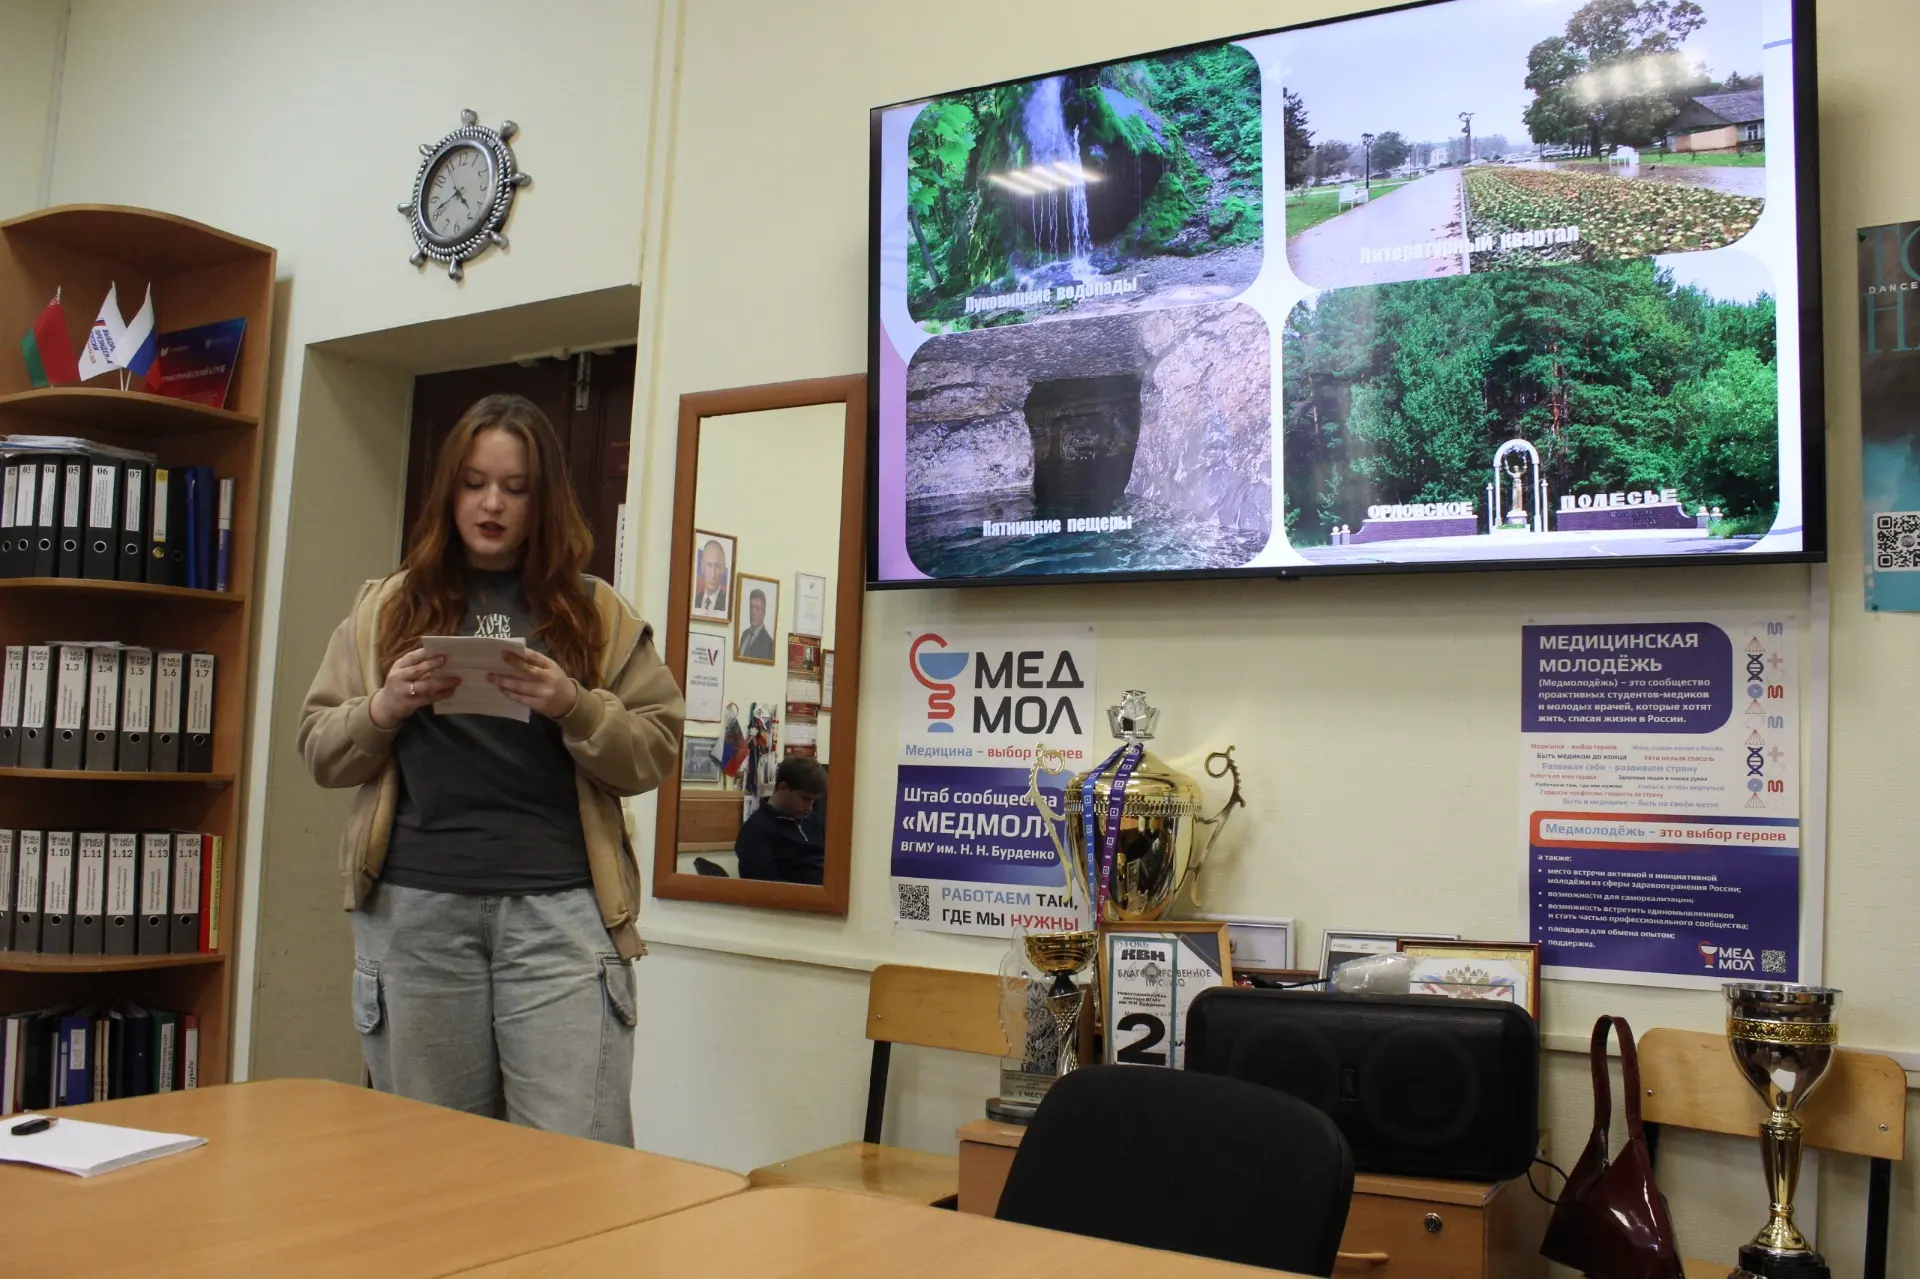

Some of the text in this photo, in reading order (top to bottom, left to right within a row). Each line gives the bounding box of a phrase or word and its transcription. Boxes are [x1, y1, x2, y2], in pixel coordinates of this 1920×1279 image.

[459, 152, 468, 167] 12
[471, 154, 479, 168] 1
[446, 160, 455, 174] 11
[478, 169, 489, 177] 2
[434, 175, 446, 188] 10
[430, 196, 440, 204] 9
[442, 219, 450, 232] 7
[454, 221, 460, 235] 6
[1500, 226, 1580, 250] квартал
[1057, 278, 1137, 301] водопады
[1869, 282, 1918, 294] DANCE
[7, 467, 16, 476] 02
[22, 466, 31, 474] 03
[45, 466, 55, 474] 04
[68, 466, 79, 475] 05
[97, 467, 108, 475] 06
[129, 471, 140, 479] 07
[1367, 488, 1678, 519] ОРЛОВСКОЕ ПОЛЕСЬЕ
[983, 515, 1132, 537] Пятницкие пещеры
[1539, 633, 1699, 652] МЕДИЦИНСКАЯ
[31, 662, 45, 671] 1.2
[65, 663, 80, 671] 1.3
[98, 665, 113, 673] 1.4
[974, 650, 1084, 689] МЕД
[1539, 655, 1662, 674] МОЛОДЁЖЬ
[130, 667, 145, 676] 1.5
[163, 668, 177, 677] 1.6
[196, 669, 209, 678] 1.7
[1538, 678, 1618, 688] (Медмолодёжь)
[1648, 678, 1711, 687] сообщество
[1538, 692, 1710, 700] проактивных студентов-медиков
[1594, 702, 1634, 712] врачей,
[1636, 704, 1680, 712] которые
[973, 696, 1082, 735] МОЛ
[1647, 714, 1687, 723] России.
[905, 744, 973, 758] Медицина
[988, 745, 1032, 761] выбор
[1615, 764, 1664, 773] развиваем
[1666, 765, 1698, 774] страну
[904, 787, 950, 803] Штаб
[1545, 823, 1645, 837] Медмолодёжь
[1659, 828, 1683, 839] это
[1686, 827, 1732, 842] выбор
[1736, 830, 1786, 843] героев
[26, 846, 38, 855] 1.9
[50, 848, 70, 857] 1.10
[82, 849, 102, 858] 1.11
[112, 849, 133, 858] 1.12
[149, 849, 169, 858] 1.13
[179, 849, 199, 858] 1.14
[900, 841, 1055, 860] ВГМУ им. Н. Н. Бурденко
[1607, 871, 1647, 879] активной
[1655, 873, 1717, 882] инициативной
[1547, 878, 1591, 886] молодёжи
[1602, 880, 1630, 888] сферы
[1631, 882, 1708, 891] здравоохранения
[1709, 884, 1742, 893] России;
[941, 887, 1031, 906] РАБОТАЕМ
[1547, 891, 1602, 900] возможности
[1621, 895, 1695, 904] самореализации;
[1547, 903, 1735, 919] возможность встретить единомышленников
[942, 909, 1079, 931] ГДЕ МЫ НУЖНЫ
[1609, 916, 1694, 926] профессионального
[1695, 920, 1749, 930] сообщества;
[1548, 926, 1590, 934] площадка
[1607, 928, 1639, 936] обмена
[1640, 931, 1676, 939] опытом;
[1548, 939, 1596, 948] поддержка.
[1121, 949, 1166, 962] КВН
[1718, 947, 1755, 960] МЕД
[1718, 960, 1755, 972] МОЛ
[1116, 1012, 1167, 1067] 2
[1024, 1091, 1044, 1099] МЕСТ
